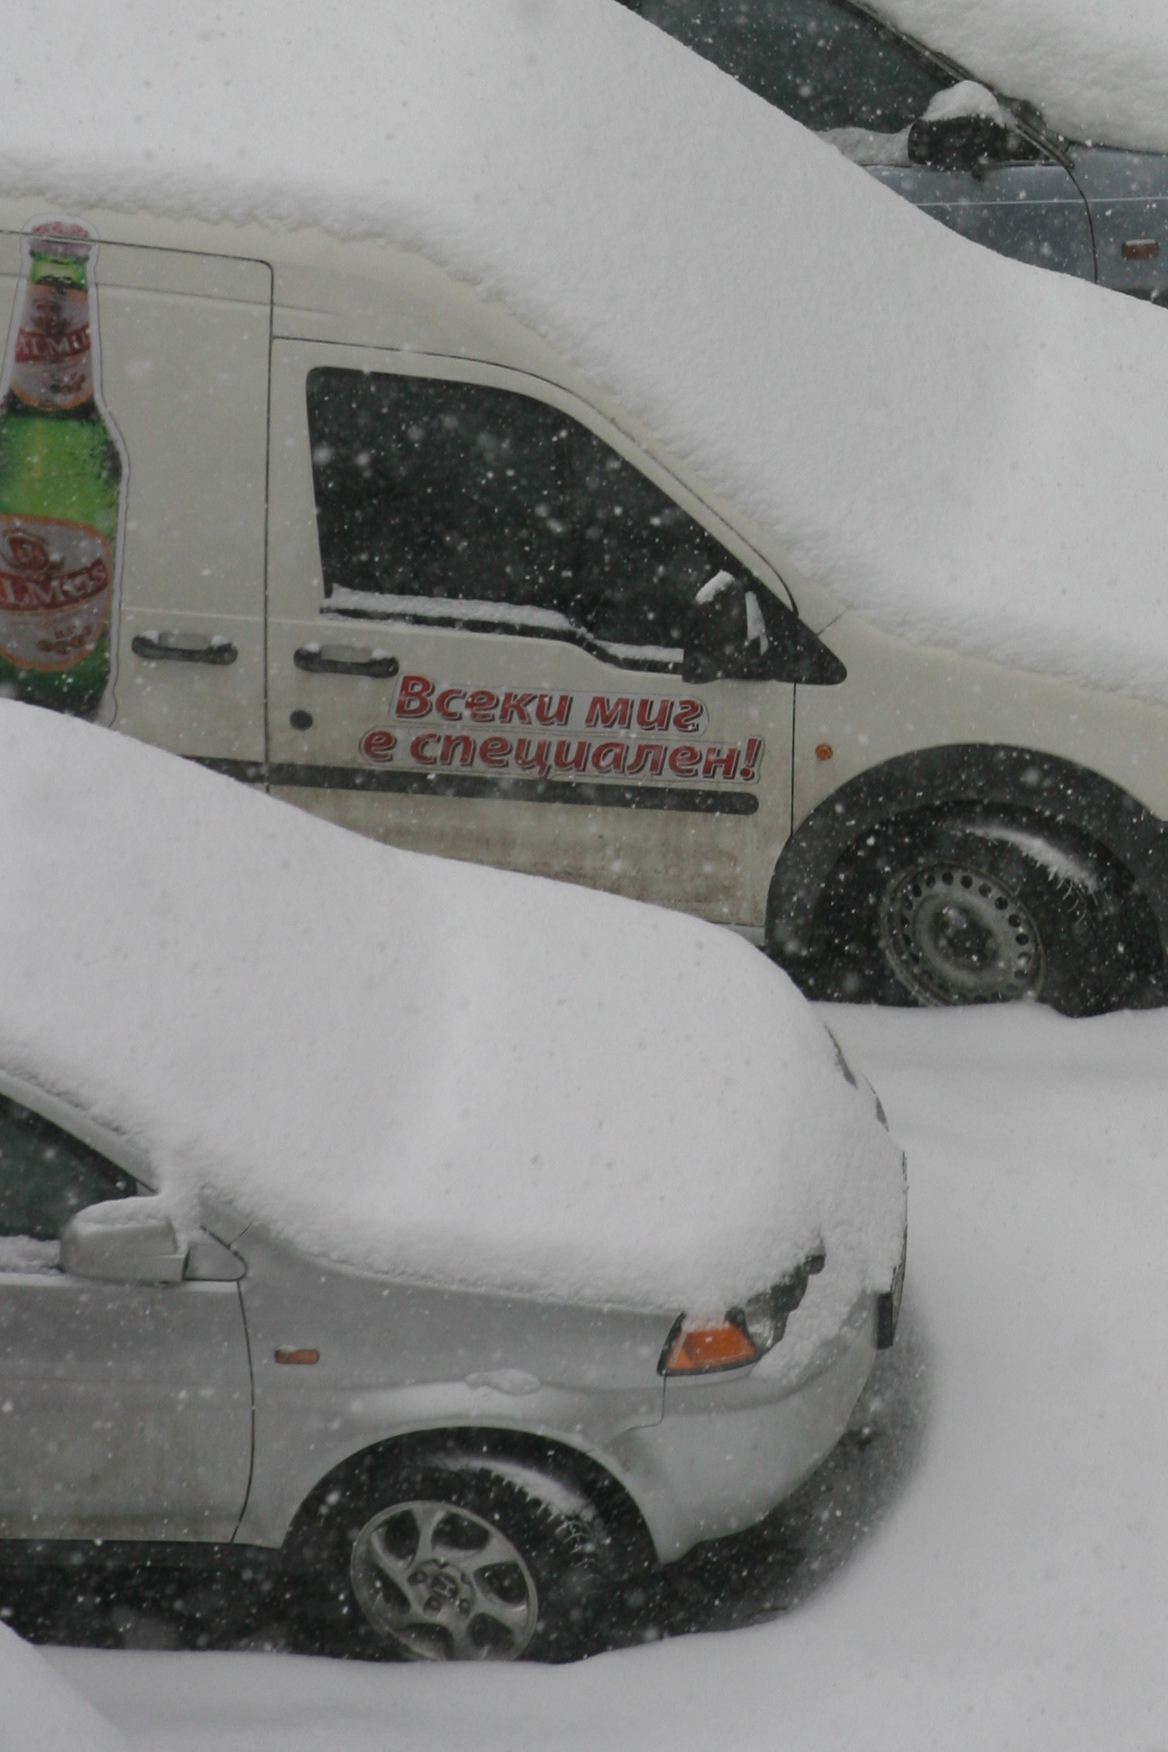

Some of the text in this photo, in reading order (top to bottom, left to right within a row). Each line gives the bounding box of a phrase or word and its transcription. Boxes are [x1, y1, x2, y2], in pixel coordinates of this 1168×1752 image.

[0, 566, 106, 604] LMUS
[395, 674, 704, 733] Всеки миг
[363, 728, 763, 782] е специален!
